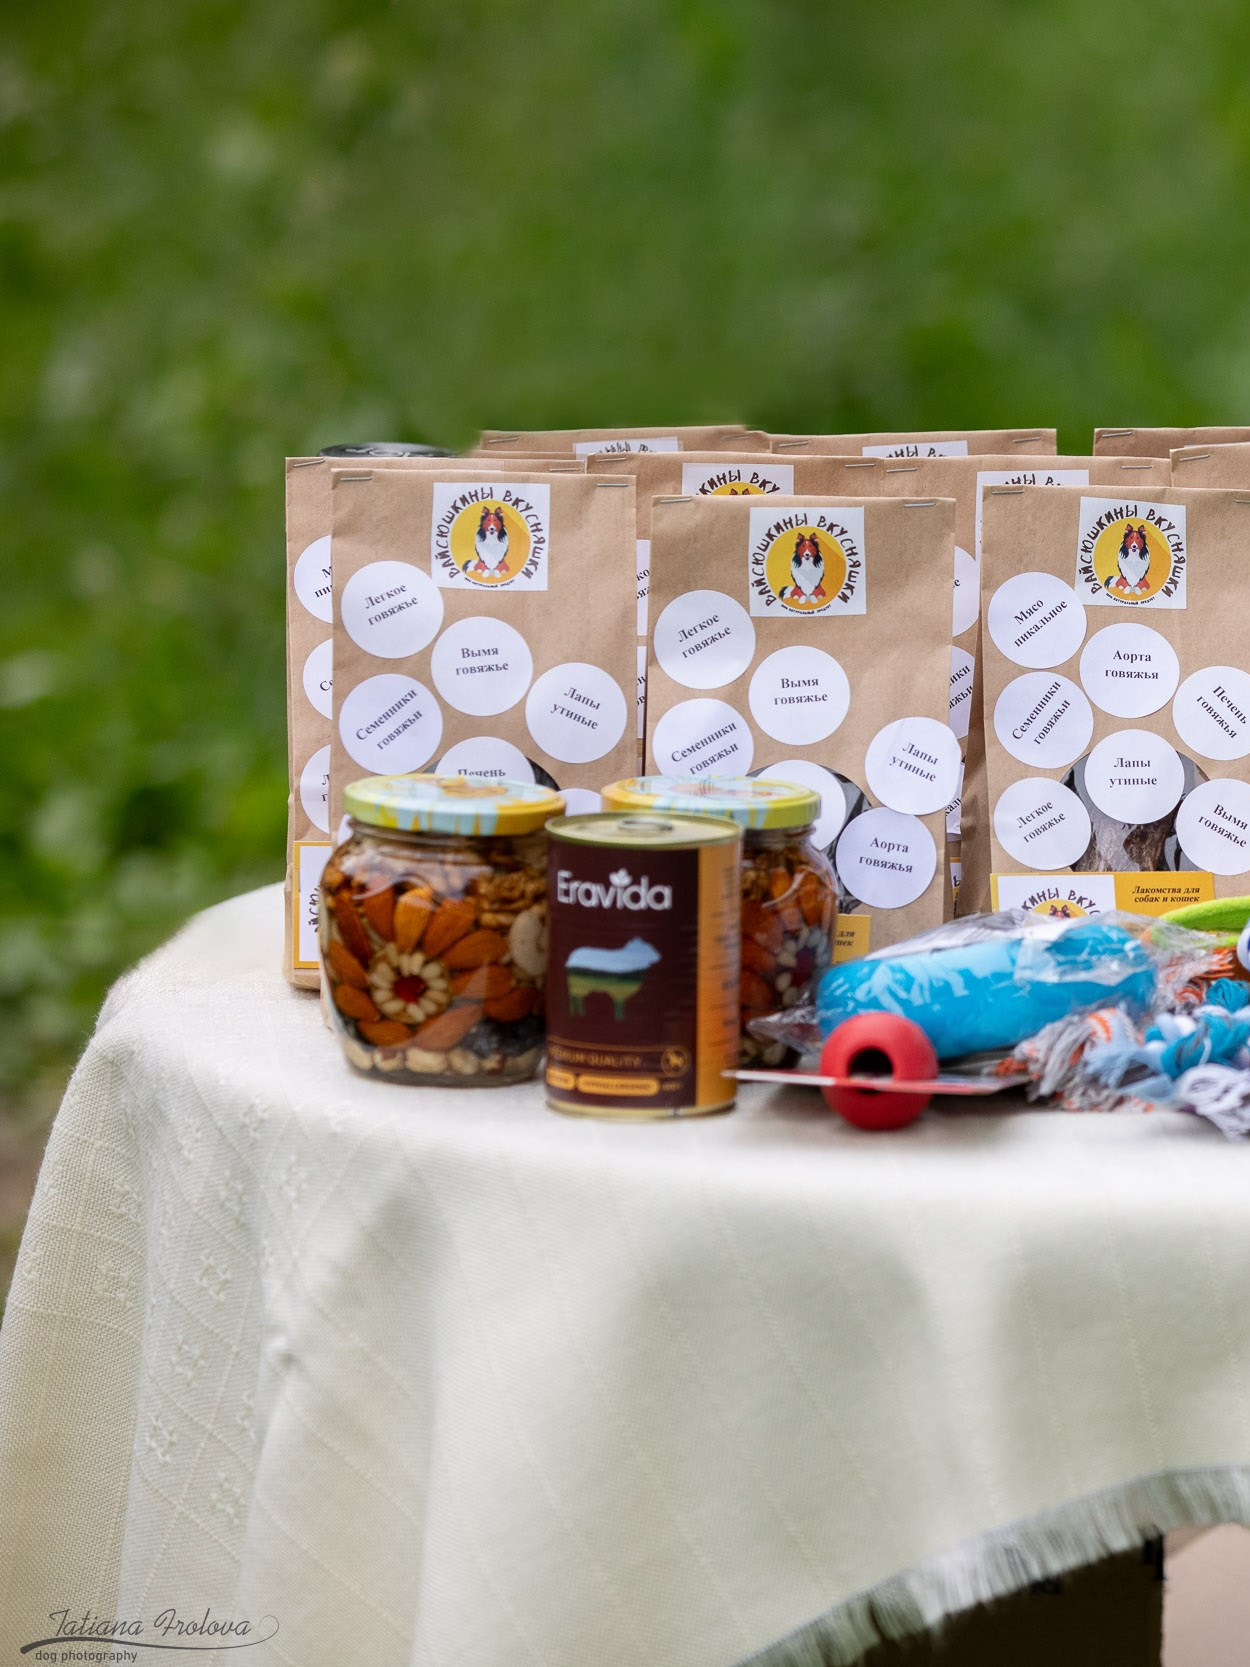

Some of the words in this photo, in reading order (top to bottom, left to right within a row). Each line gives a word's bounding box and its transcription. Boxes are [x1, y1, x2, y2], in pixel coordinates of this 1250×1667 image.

[435, 486, 493, 579] ВАЙСЮШКИНЫ
[503, 490, 546, 579] ВКУСНЯШКИ
[751, 513, 807, 607] ВАЙСЮШКИНЫ
[817, 515, 861, 604] ВКУСНЯШКИ
[1079, 505, 1137, 595] ВАЙСЮШКИНЫ
[1146, 508, 1186, 598] ВКУСНЯШКИ
[364, 584, 407, 610] Легкое
[367, 595, 419, 626] говяжье
[1014, 599, 1044, 626] Мясо
[1014, 600, 1068, 648] пикальное
[678, 612, 720, 643] Легкое
[681, 624, 732, 659] говяжье
[461, 646, 500, 659] Вымя
[1113, 649, 1152, 663] Аорта
[456, 661, 509, 676] говяжье
[781, 676, 820, 689] Вымя
[1105, 668, 1159, 680] говяжья
[564, 687, 601, 711] Лапы
[774, 691, 828, 706] говяжье
[1012, 681, 1061, 741] Семенники
[1212, 685, 1247, 725] Печень
[355, 688, 417, 742] Семенники
[550, 702, 599, 730] утиные
[1033, 699, 1071, 746] говяжьи
[1196, 696, 1238, 739] говяжья
[376, 709, 424, 751] говяжьи
[671, 720, 738, 764] Семенники
[689, 742, 740, 776] говяжьи
[888, 754, 938, 783] утиные
[902, 742, 938, 766] Лапы
[1114, 757, 1151, 769] Лапы
[1109, 776, 1158, 788] утиные
[1017, 800, 1054, 829] Легкое
[1023, 813, 1066, 844] говяжье
[1213, 804, 1249, 831] Вымя
[870, 837, 909, 854] Аорта
[1198, 815, 1248, 848] говяжье
[859, 856, 913, 874] говяжья
[557, 869, 672, 911] Eravida
[1132, 885, 1182, 895] Лакомства
[1184, 886, 1201, 895] для
[1134, 894, 1160, 903] собак
[1169, 895, 1201, 903] кошек
